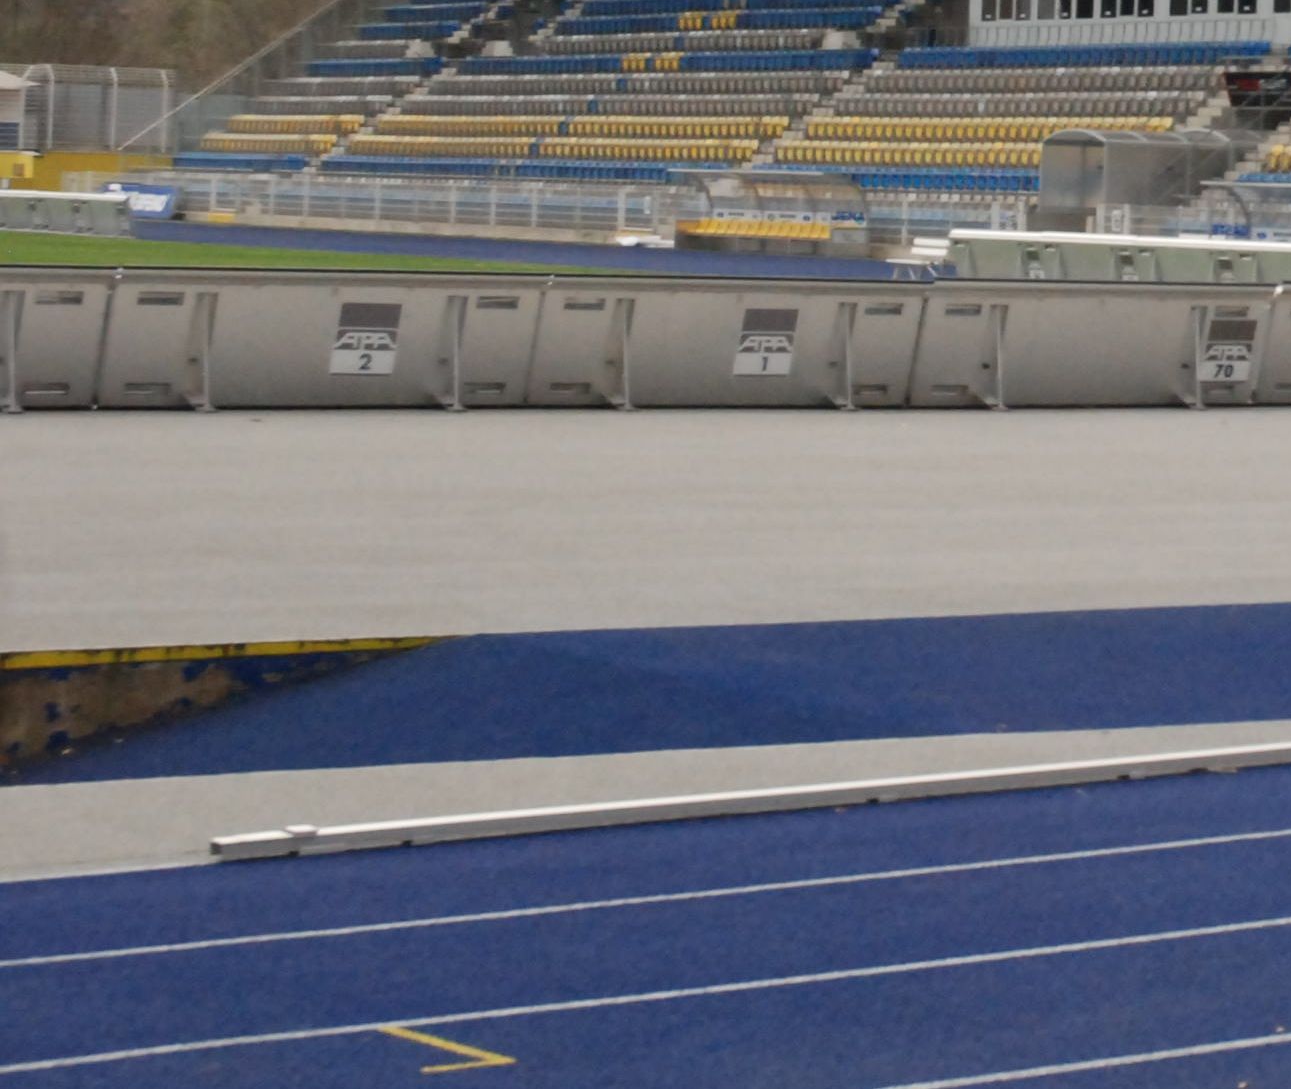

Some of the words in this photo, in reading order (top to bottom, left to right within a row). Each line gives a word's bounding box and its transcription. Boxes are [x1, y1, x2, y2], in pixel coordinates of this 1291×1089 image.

[358, 353, 372, 370] 2
[761, 356, 769, 372] 1
[1214, 364, 1234, 378] 70
